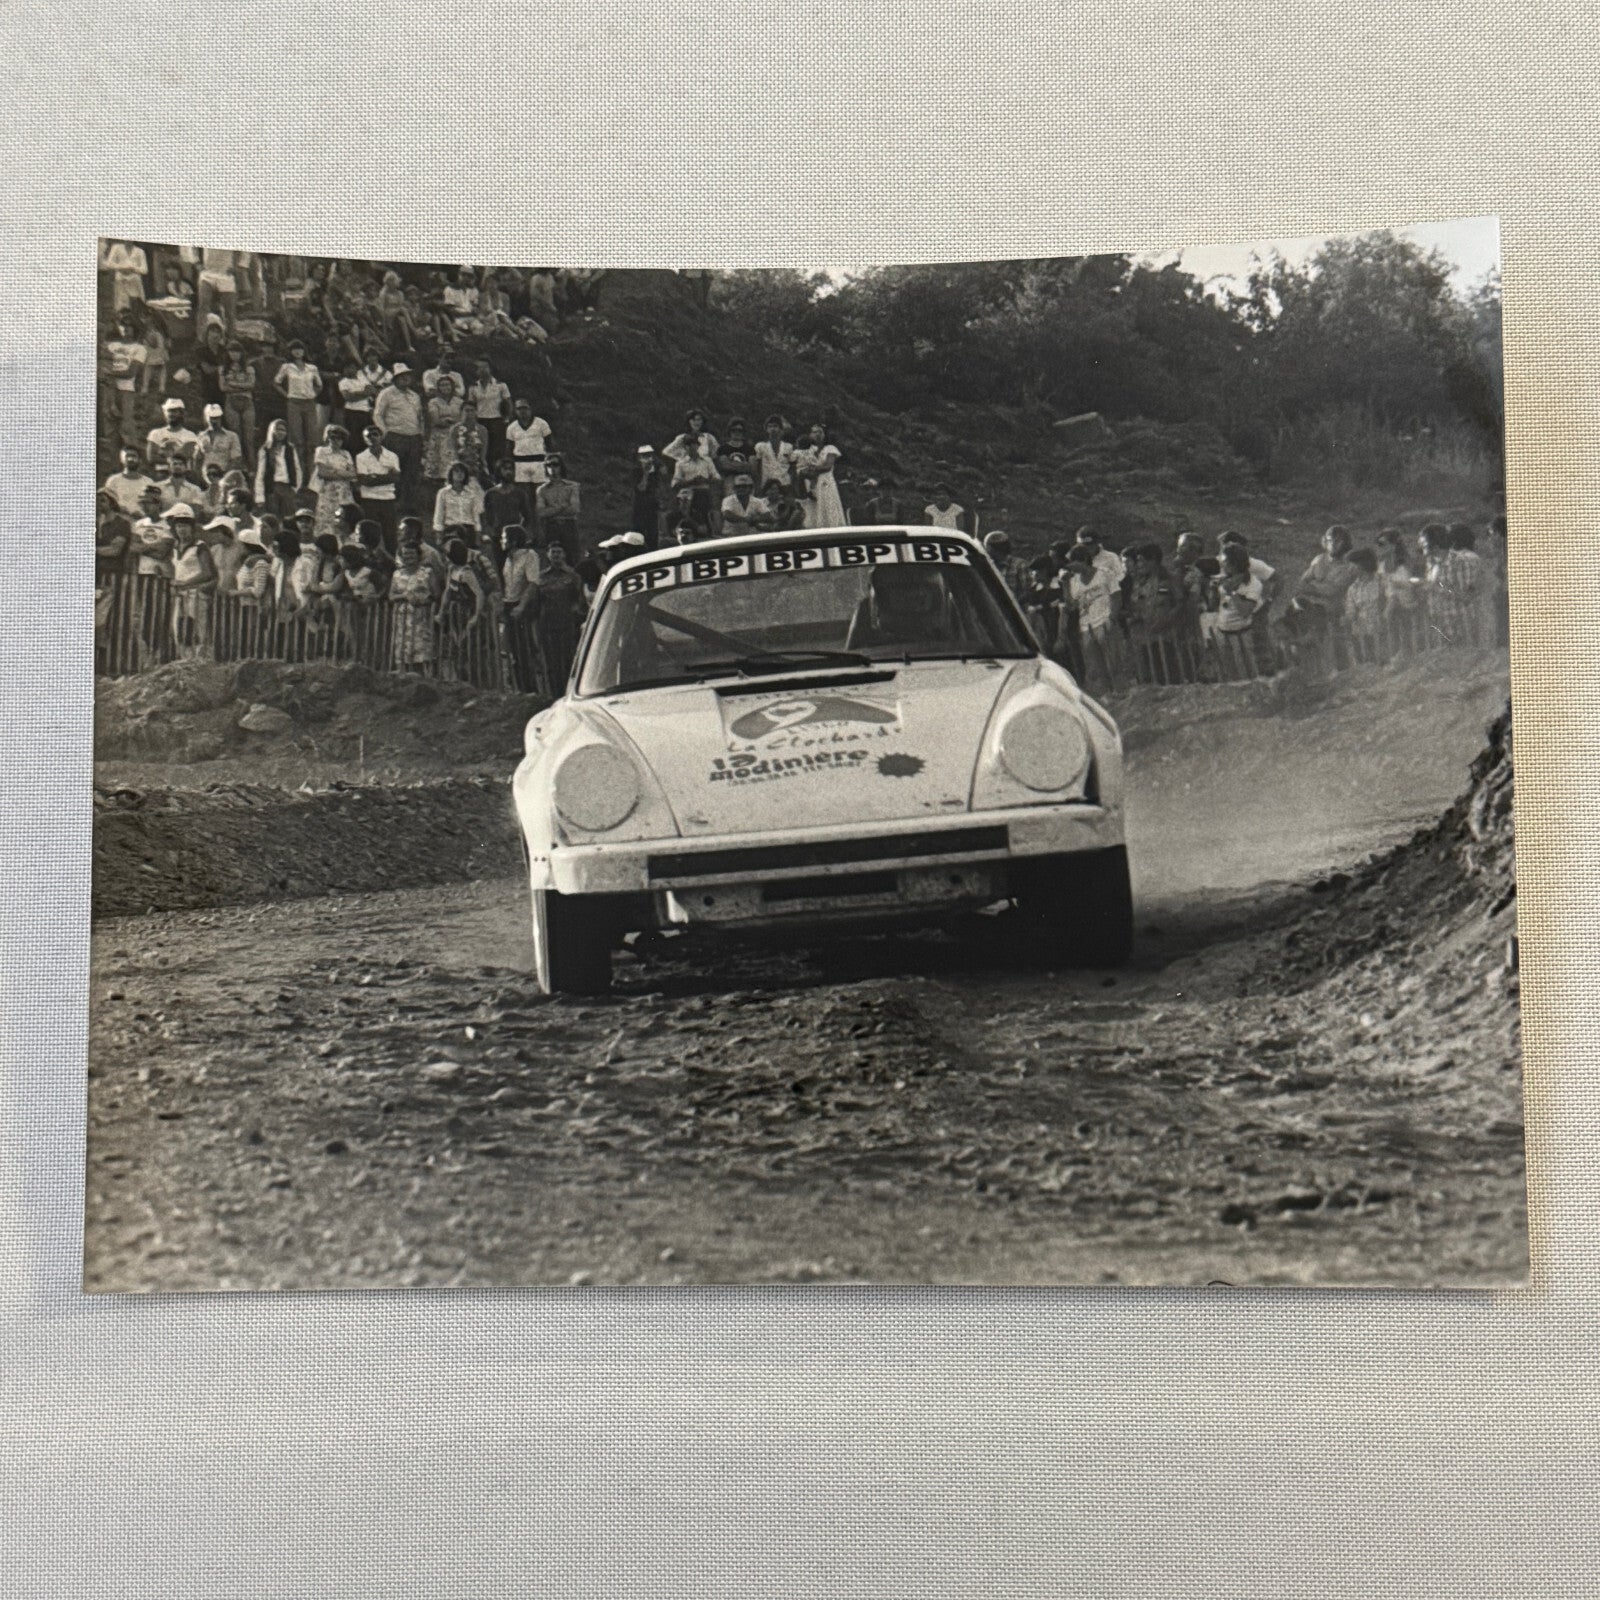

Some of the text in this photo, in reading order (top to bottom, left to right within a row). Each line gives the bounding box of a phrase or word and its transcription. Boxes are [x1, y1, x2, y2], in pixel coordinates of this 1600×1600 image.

[621, 542, 963, 598] BP BP BP BP BP
[711, 753, 757, 770] la
